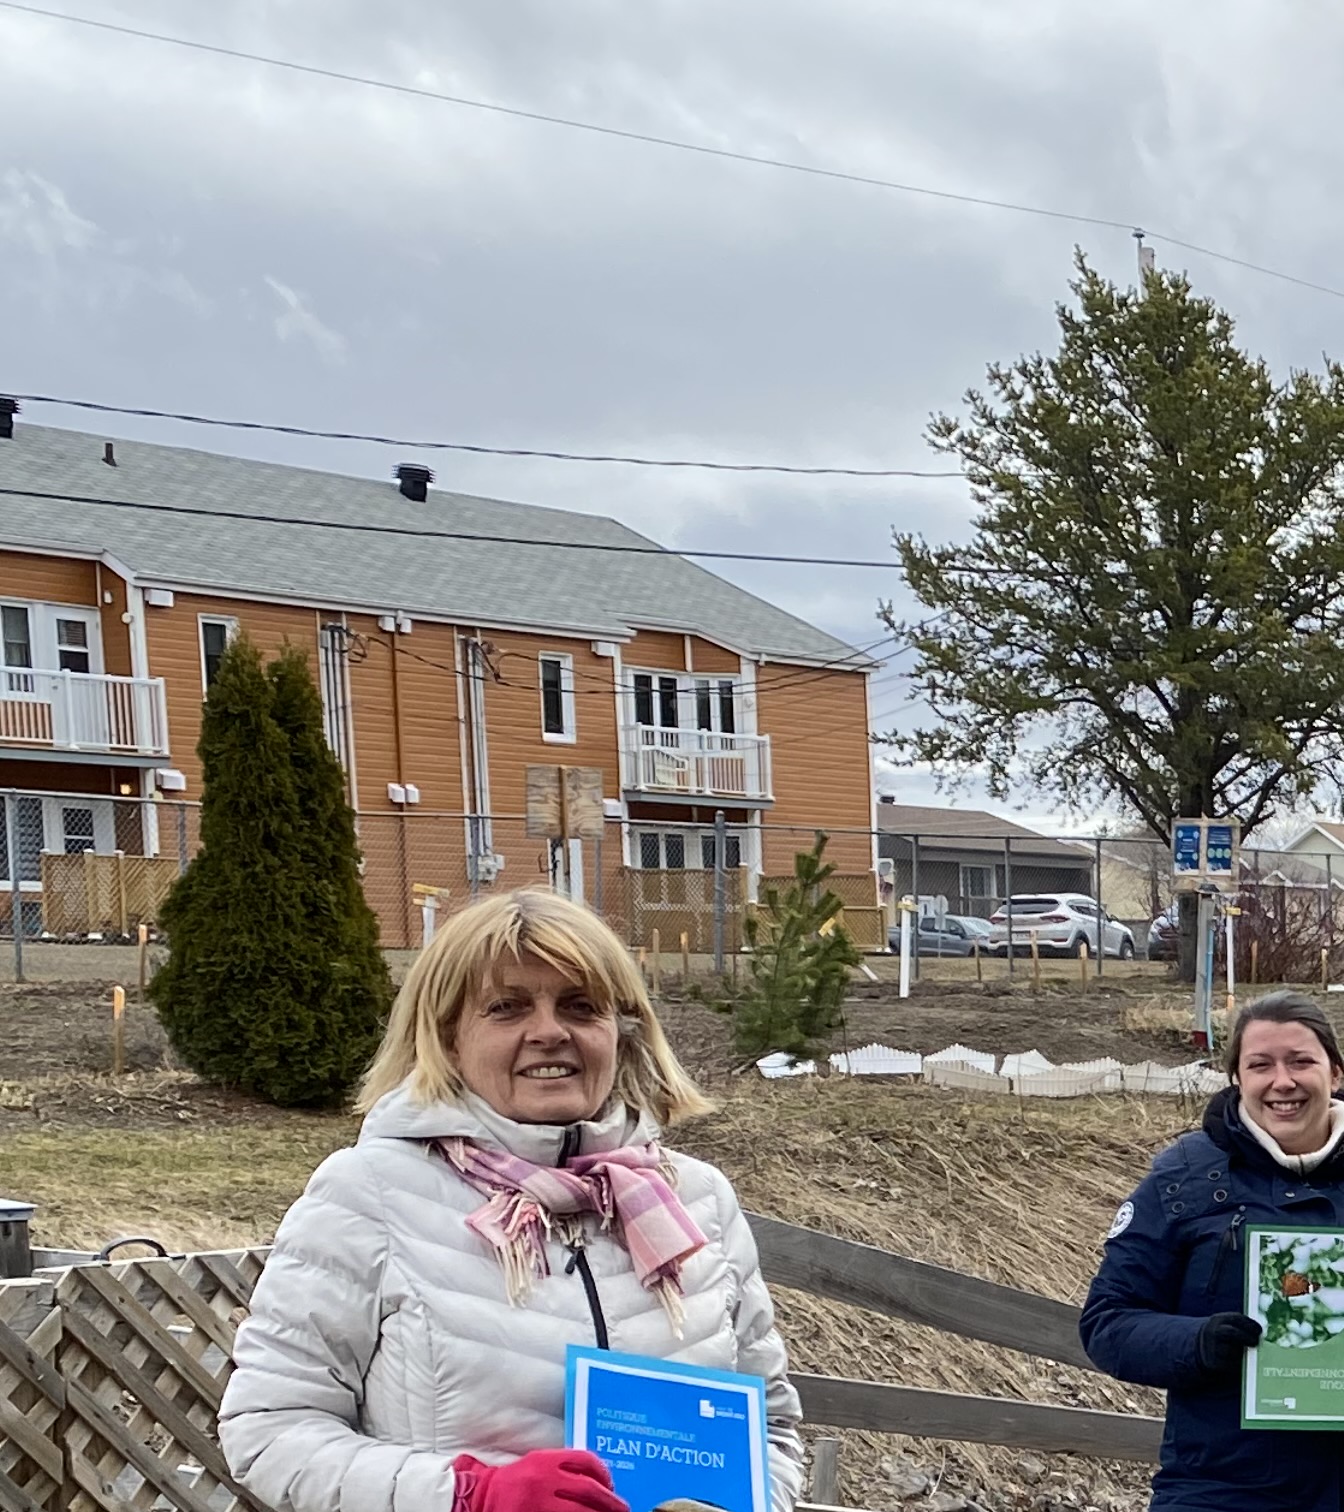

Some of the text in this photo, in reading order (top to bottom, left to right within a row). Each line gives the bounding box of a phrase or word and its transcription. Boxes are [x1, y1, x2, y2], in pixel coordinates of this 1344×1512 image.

[596, 1407, 648, 1425] POLITIQUE
[596, 1418, 697, 1444] ENVIRONNEMENTALE
[595, 1435, 726, 1469] PLAN D'ACTION
